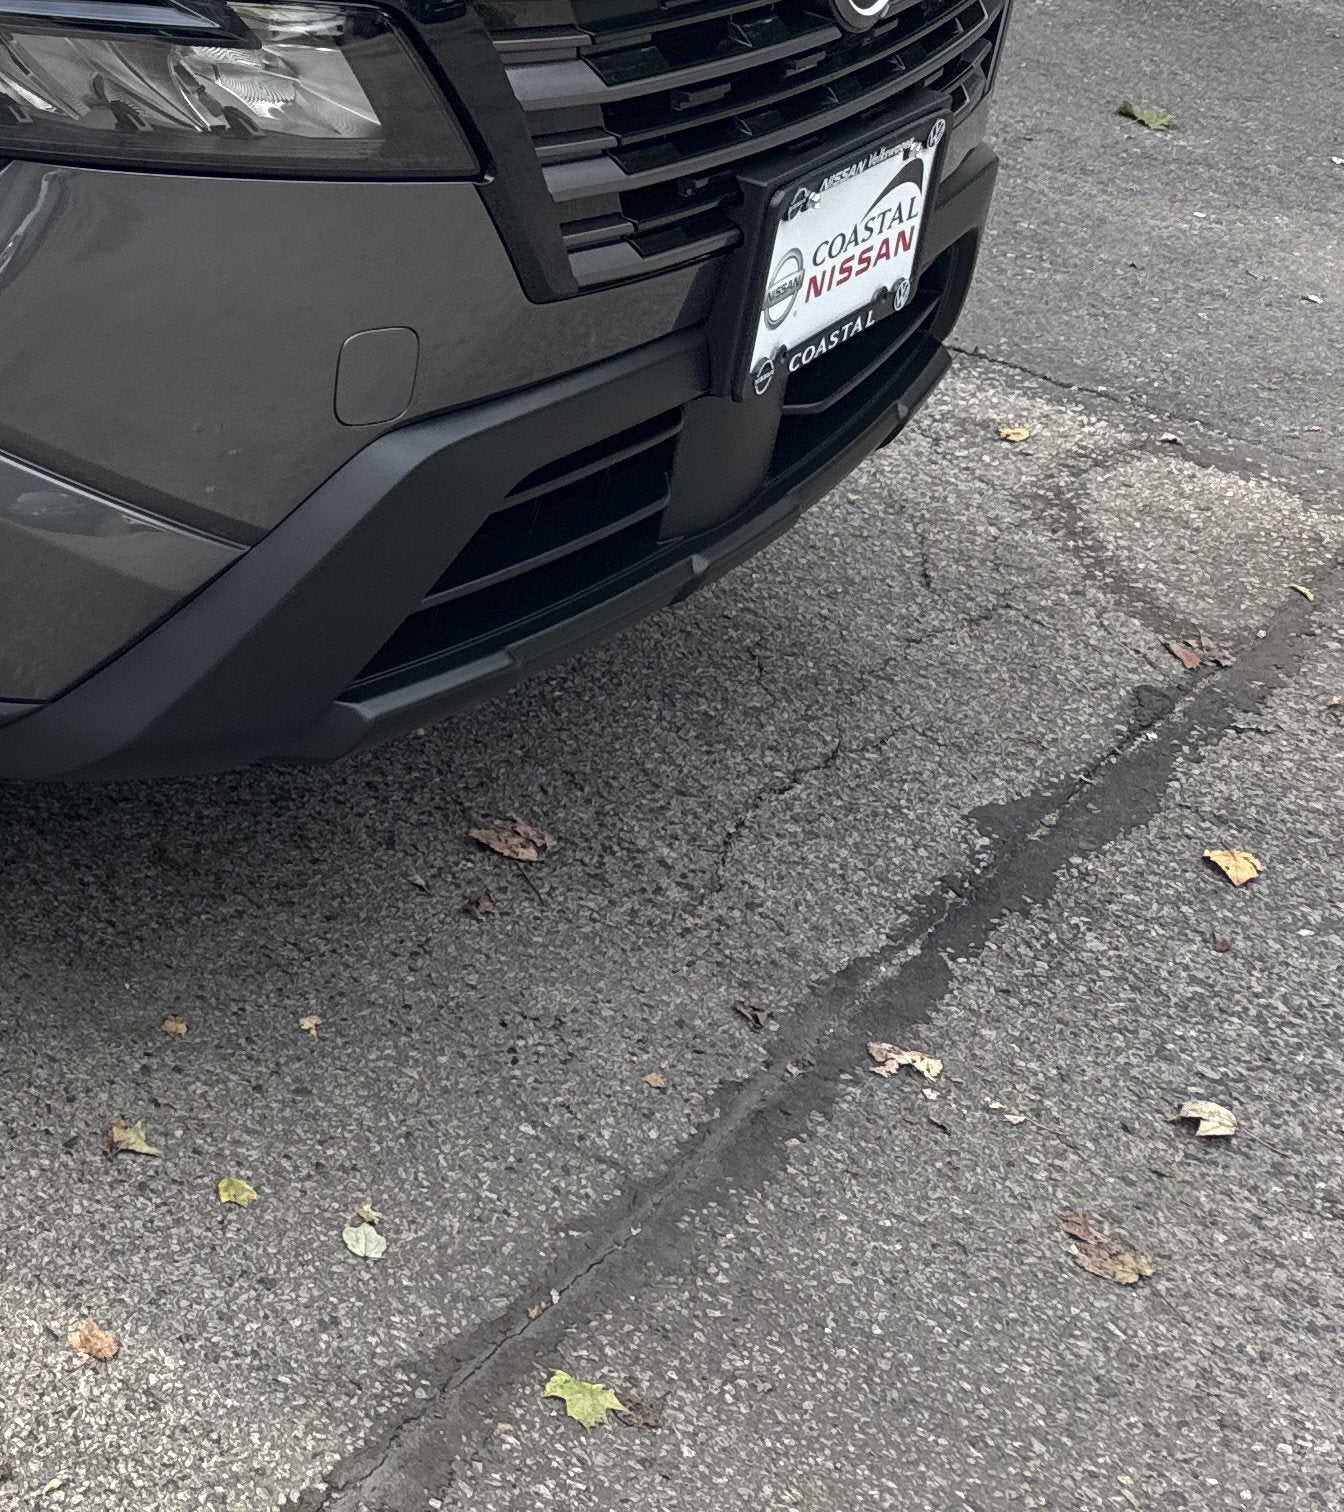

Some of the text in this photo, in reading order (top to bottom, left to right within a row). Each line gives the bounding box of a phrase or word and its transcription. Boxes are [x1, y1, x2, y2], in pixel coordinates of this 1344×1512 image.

[805, 225, 915, 304] NISSAN
[812, 196, 918, 267] COASTAL
[767, 273, 802, 303] NISSAN
[789, 309, 876, 372] COASTAL
